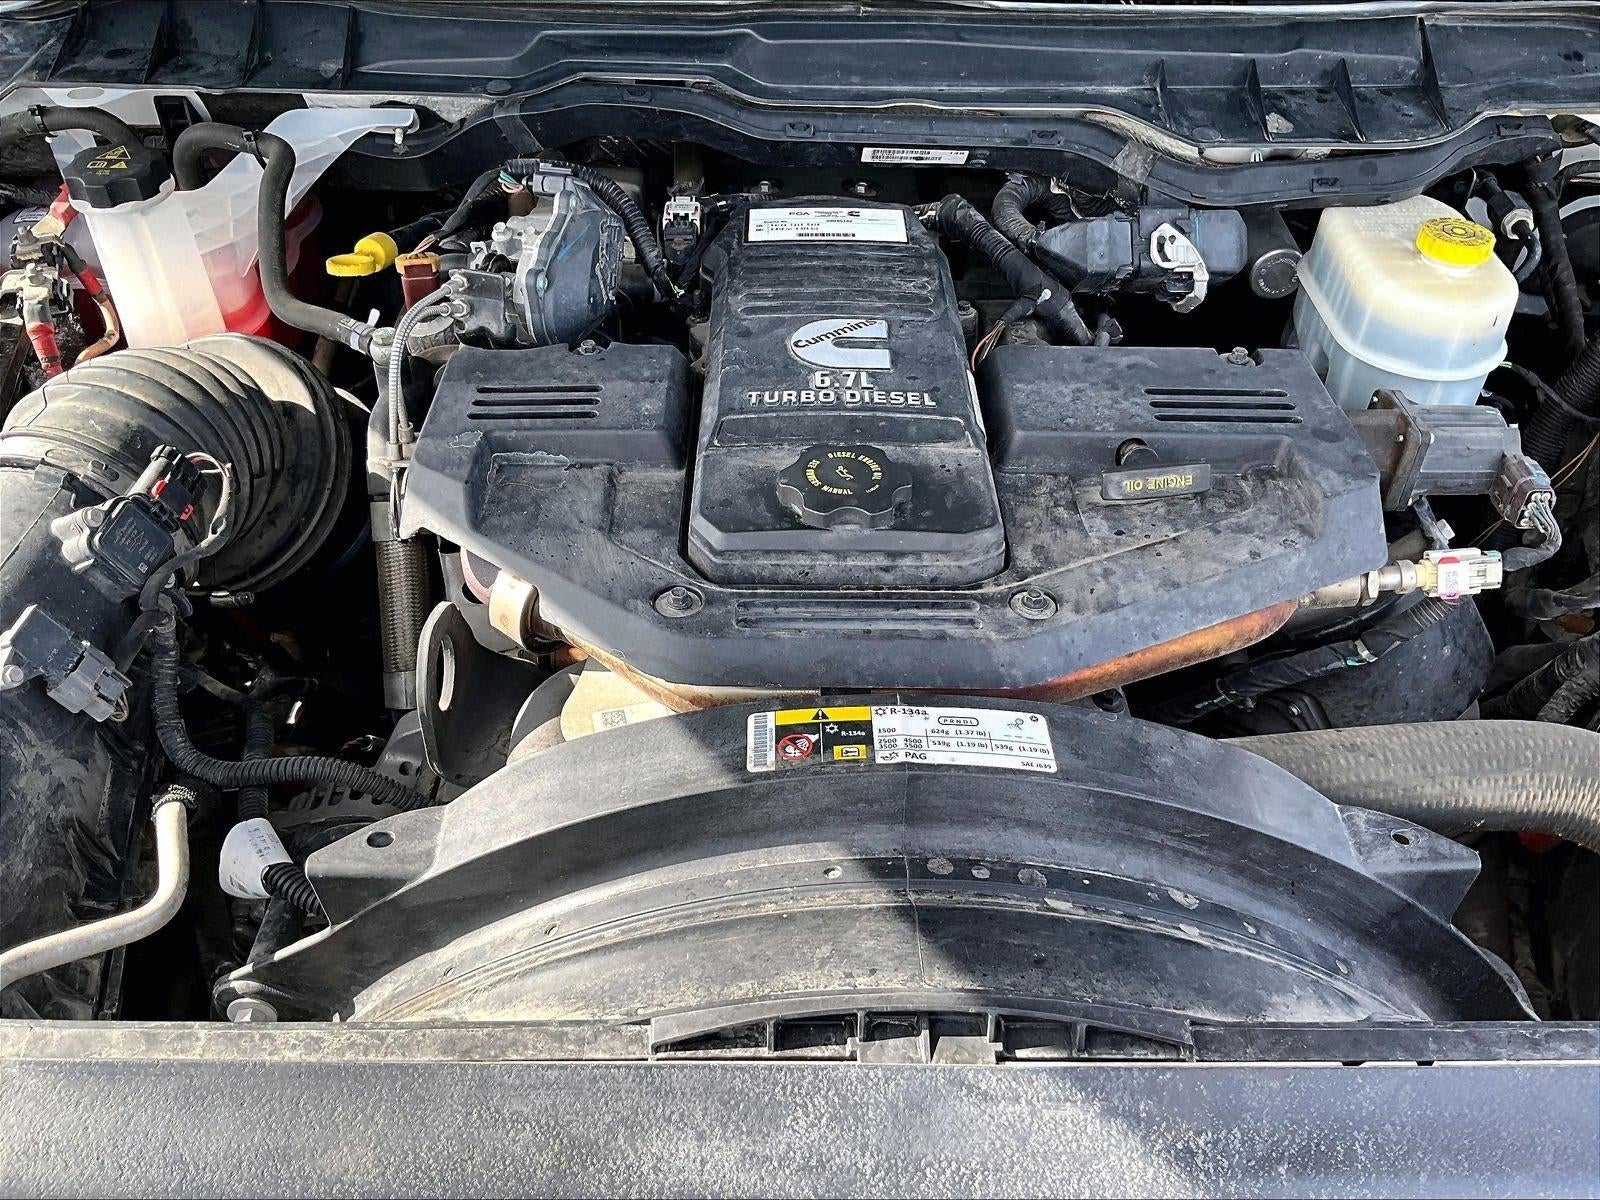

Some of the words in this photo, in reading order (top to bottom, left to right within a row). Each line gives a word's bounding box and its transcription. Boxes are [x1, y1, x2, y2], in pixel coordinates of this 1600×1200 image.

[793, 320, 877, 349] Cummins
[814, 370, 874, 390] 6.7L
[748, 391, 835, 406] TURBO
[844, 391, 937, 407] DIESEL
[822, 485, 853, 495] MANUAL
[1123, 480, 1143, 491] OIL
[1146, 475, 1193, 490] ENGINE
[905, 752, 927, 760] PAG
